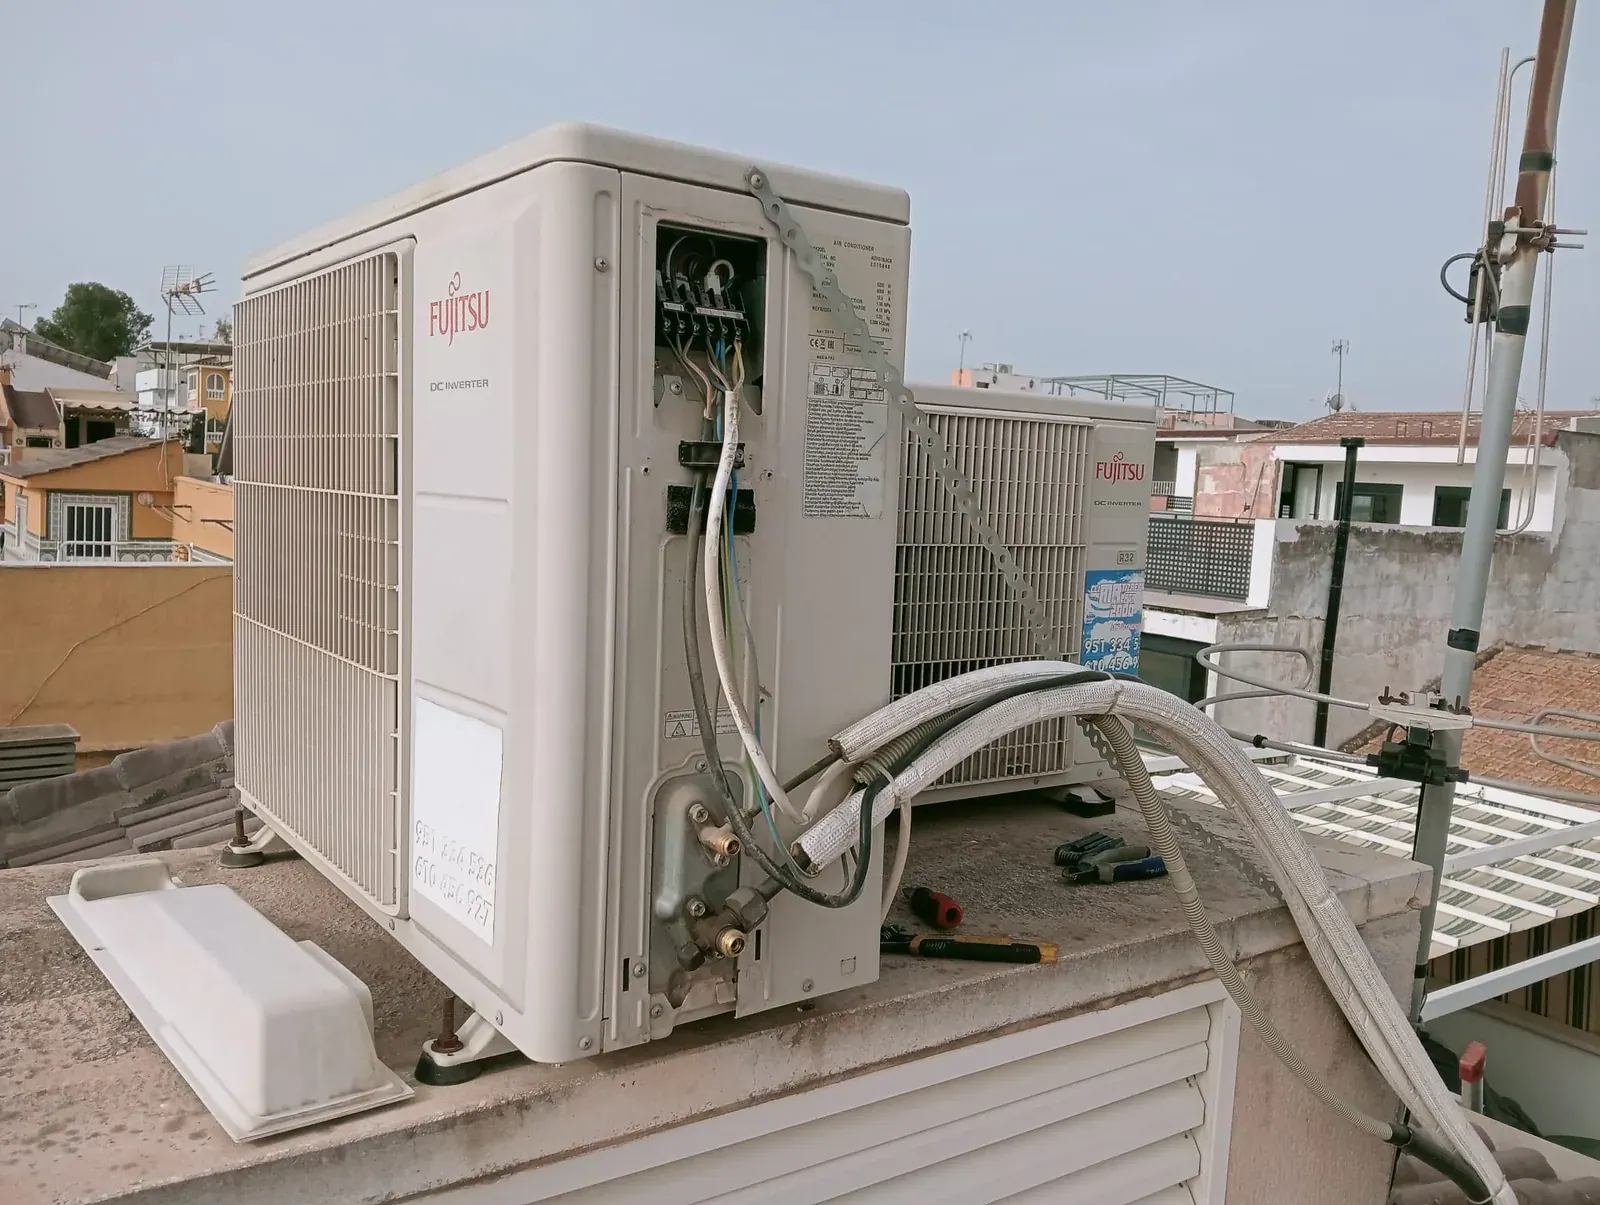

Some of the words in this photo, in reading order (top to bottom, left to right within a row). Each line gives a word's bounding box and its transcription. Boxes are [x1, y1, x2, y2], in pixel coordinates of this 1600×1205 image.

[844, 241, 875, 252] CONDITIONER
[429, 290, 490, 347] FUJITSU
[430, 382, 444, 392] DC
[445, 378, 489, 391] INVERTER
[1096, 462, 1145, 486] FUJITSU
[1119, 553, 1134, 563] R32
[1084, 639, 1105, 654] 951
[1109, 637, 1131, 653] 334
[1108, 655, 1130, 671] 456
